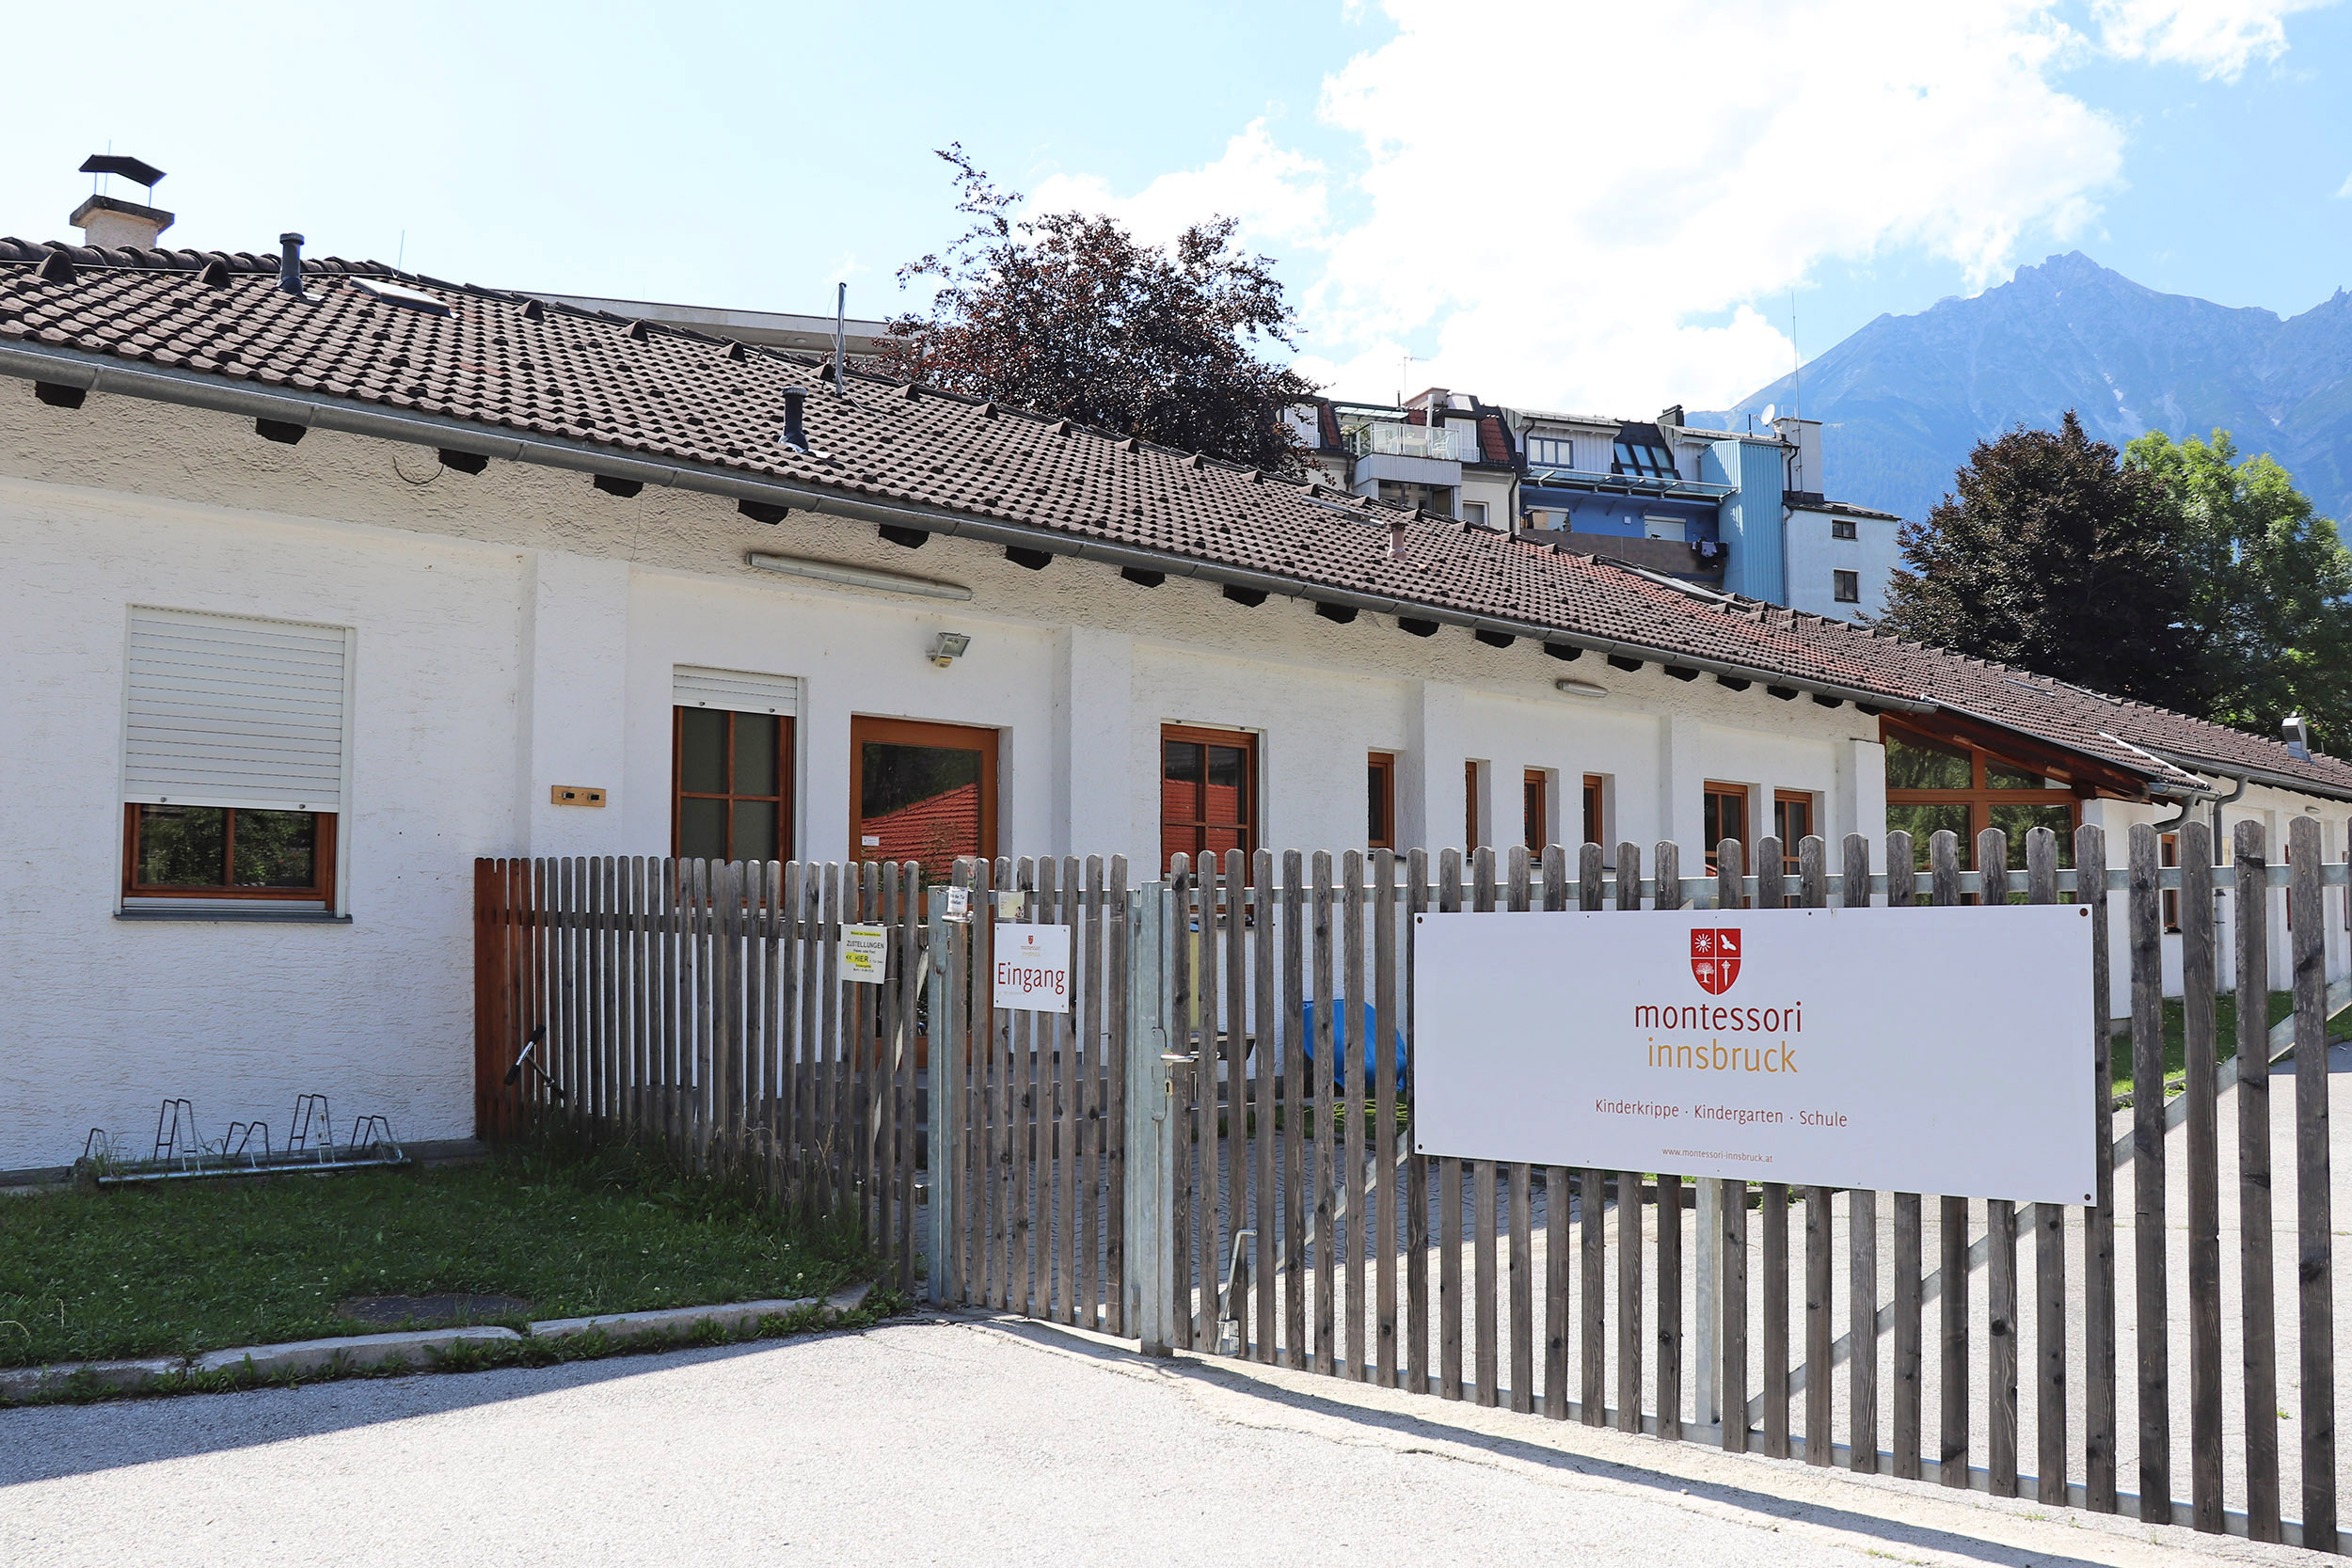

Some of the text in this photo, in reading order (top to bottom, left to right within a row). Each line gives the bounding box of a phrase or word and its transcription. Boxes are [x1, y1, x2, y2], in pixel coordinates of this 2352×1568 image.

[847, 940, 884, 949] ZUSTELLUNGEN
[997, 961, 1065, 995] Eingang
[1635, 1001, 1802, 1033] montessori
[1648, 1037, 1798, 1072] innsbruck
[1596, 1099, 1848, 1128] Kinderkrippe Kindergarten Schule
[1661, 1148, 1773, 1164] www.montessori-innsbruck.at
